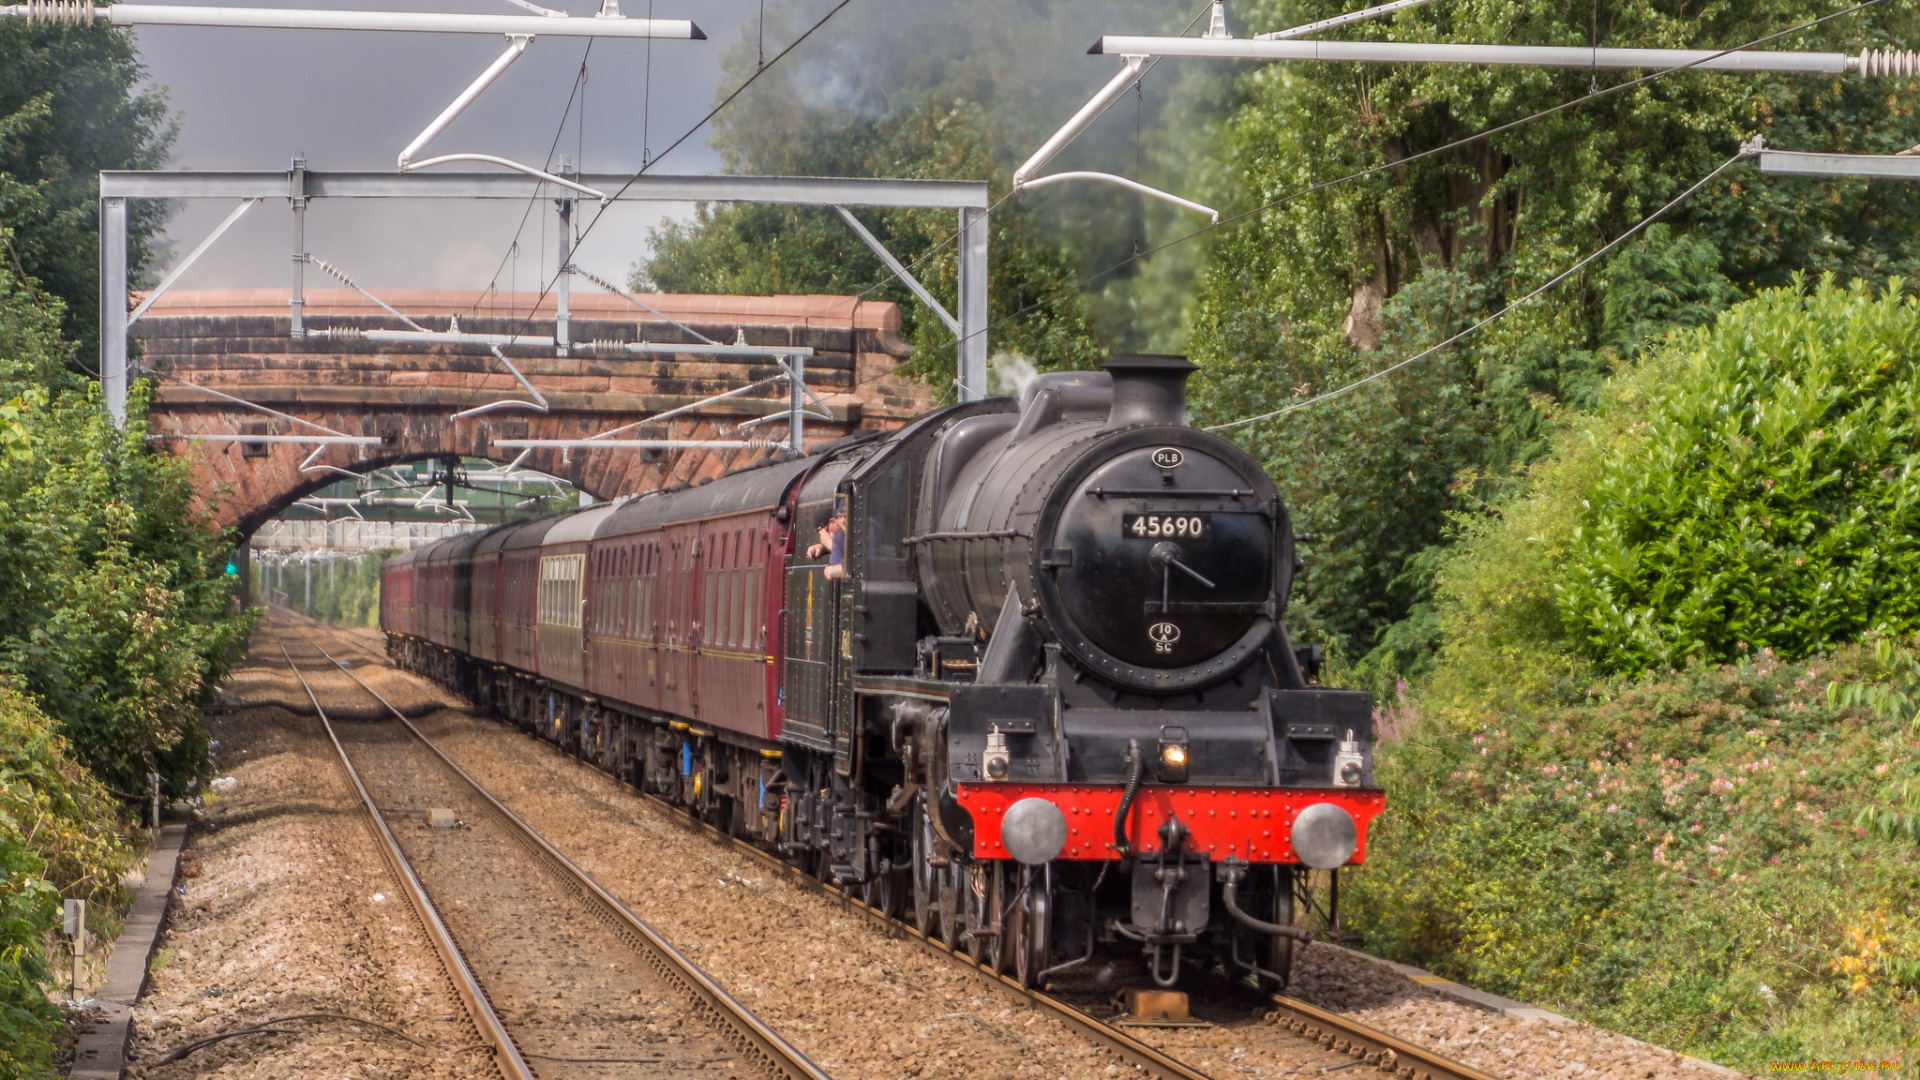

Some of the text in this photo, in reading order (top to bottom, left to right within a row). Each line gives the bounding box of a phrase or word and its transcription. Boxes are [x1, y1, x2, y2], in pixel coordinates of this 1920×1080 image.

[1158, 453, 1178, 463] PLB
[1132, 516, 1202, 536] 45690
[1160, 624, 1171, 634] 10
[1161, 634, 1167, 642] A
[1156, 642, 1171, 652] SC
